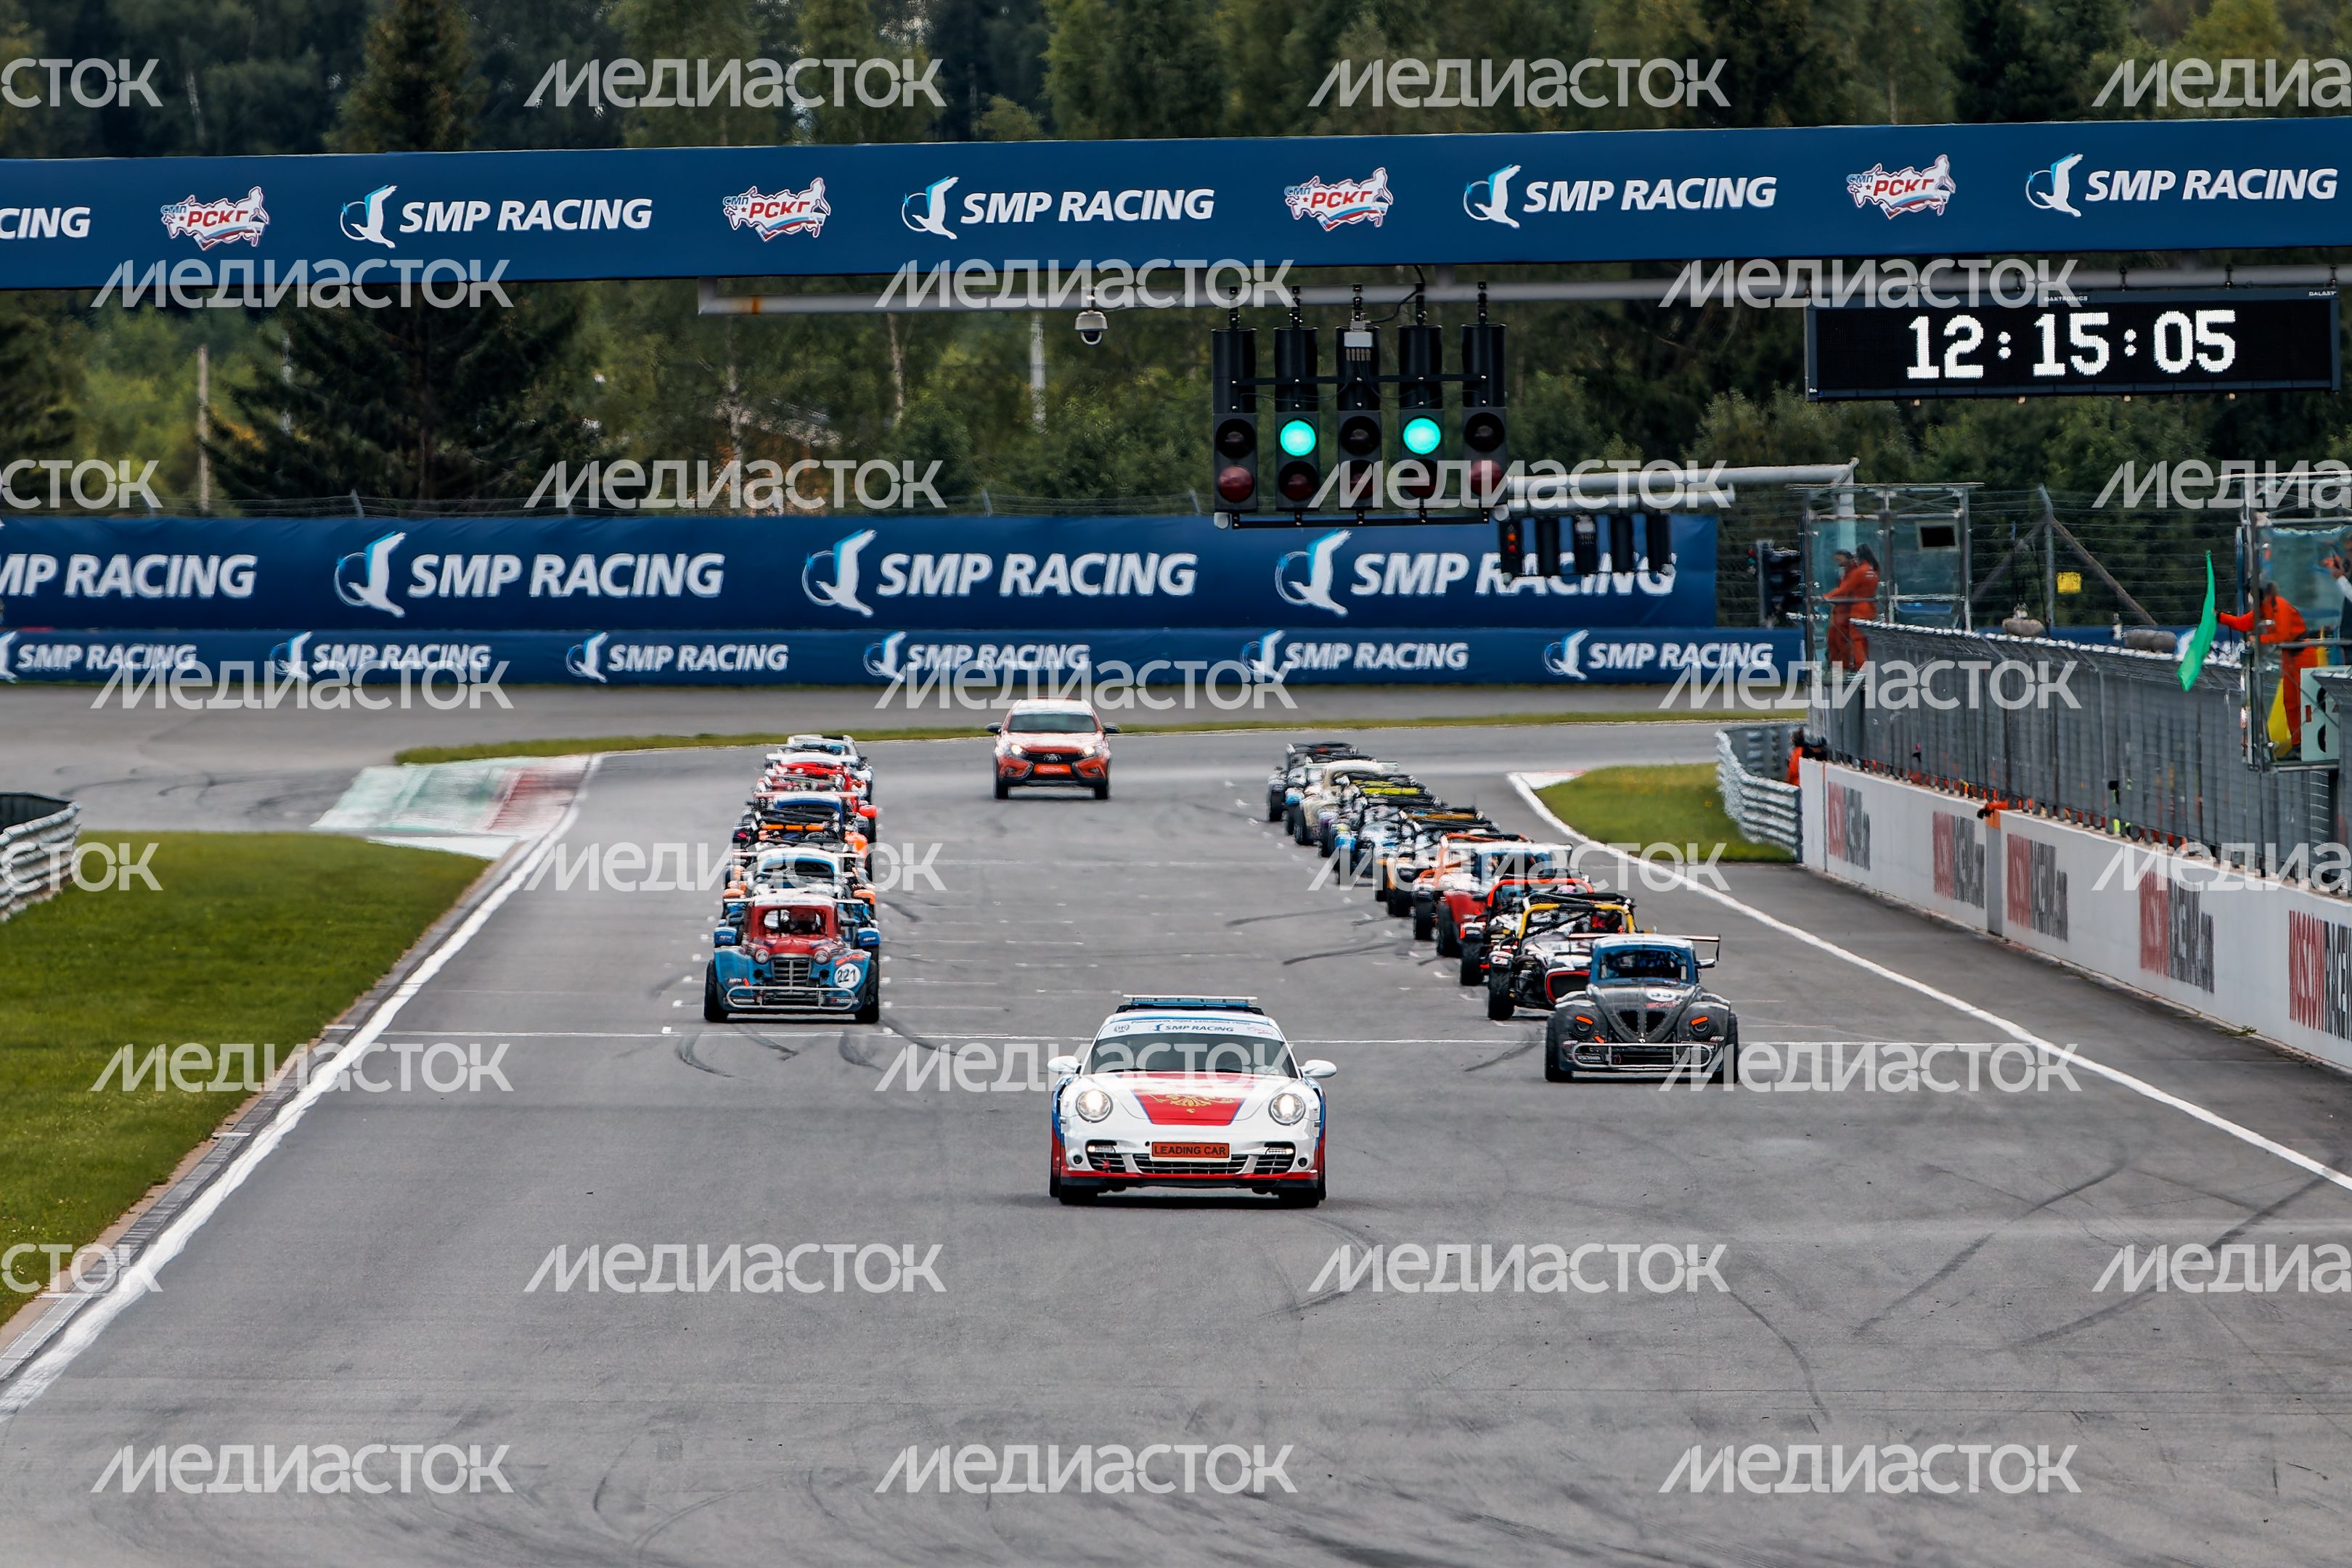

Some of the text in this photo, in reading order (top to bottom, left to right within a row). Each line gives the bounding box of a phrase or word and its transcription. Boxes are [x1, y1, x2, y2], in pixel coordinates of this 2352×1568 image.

[1523, 176, 1778, 213] SMP RACING
[1873, 179, 1935, 197] РСКГ
[2085, 167, 2339, 203] SMP RACING
[748, 200, 811, 219] РСКГ
[960, 188, 1216, 224] SMP RACING
[1310, 189, 1373, 209] РСКГ
[187, 210, 248, 227] РСКГ
[399, 198, 653, 233] SMP RACING
[63, 554, 258, 599] RACING
[407, 552, 726, 598] SMP RACING
[875, 552, 1198, 597] SMP RACING
[1350, 552, 1469, 596] SMP
[15, 644, 197, 671] SMP RACING
[312, 644, 491, 670] SMP RACING
[607, 644, 789, 671] SMP RACING
[906, 644, 1090, 670] SMP RACING
[1285, 642, 1469, 670] SMP RACING
[1588, 642, 1773, 669] SMP RACING
[837, 968, 857, 983] 221
[1153, 1146, 1226, 1156] LEADING CAR
